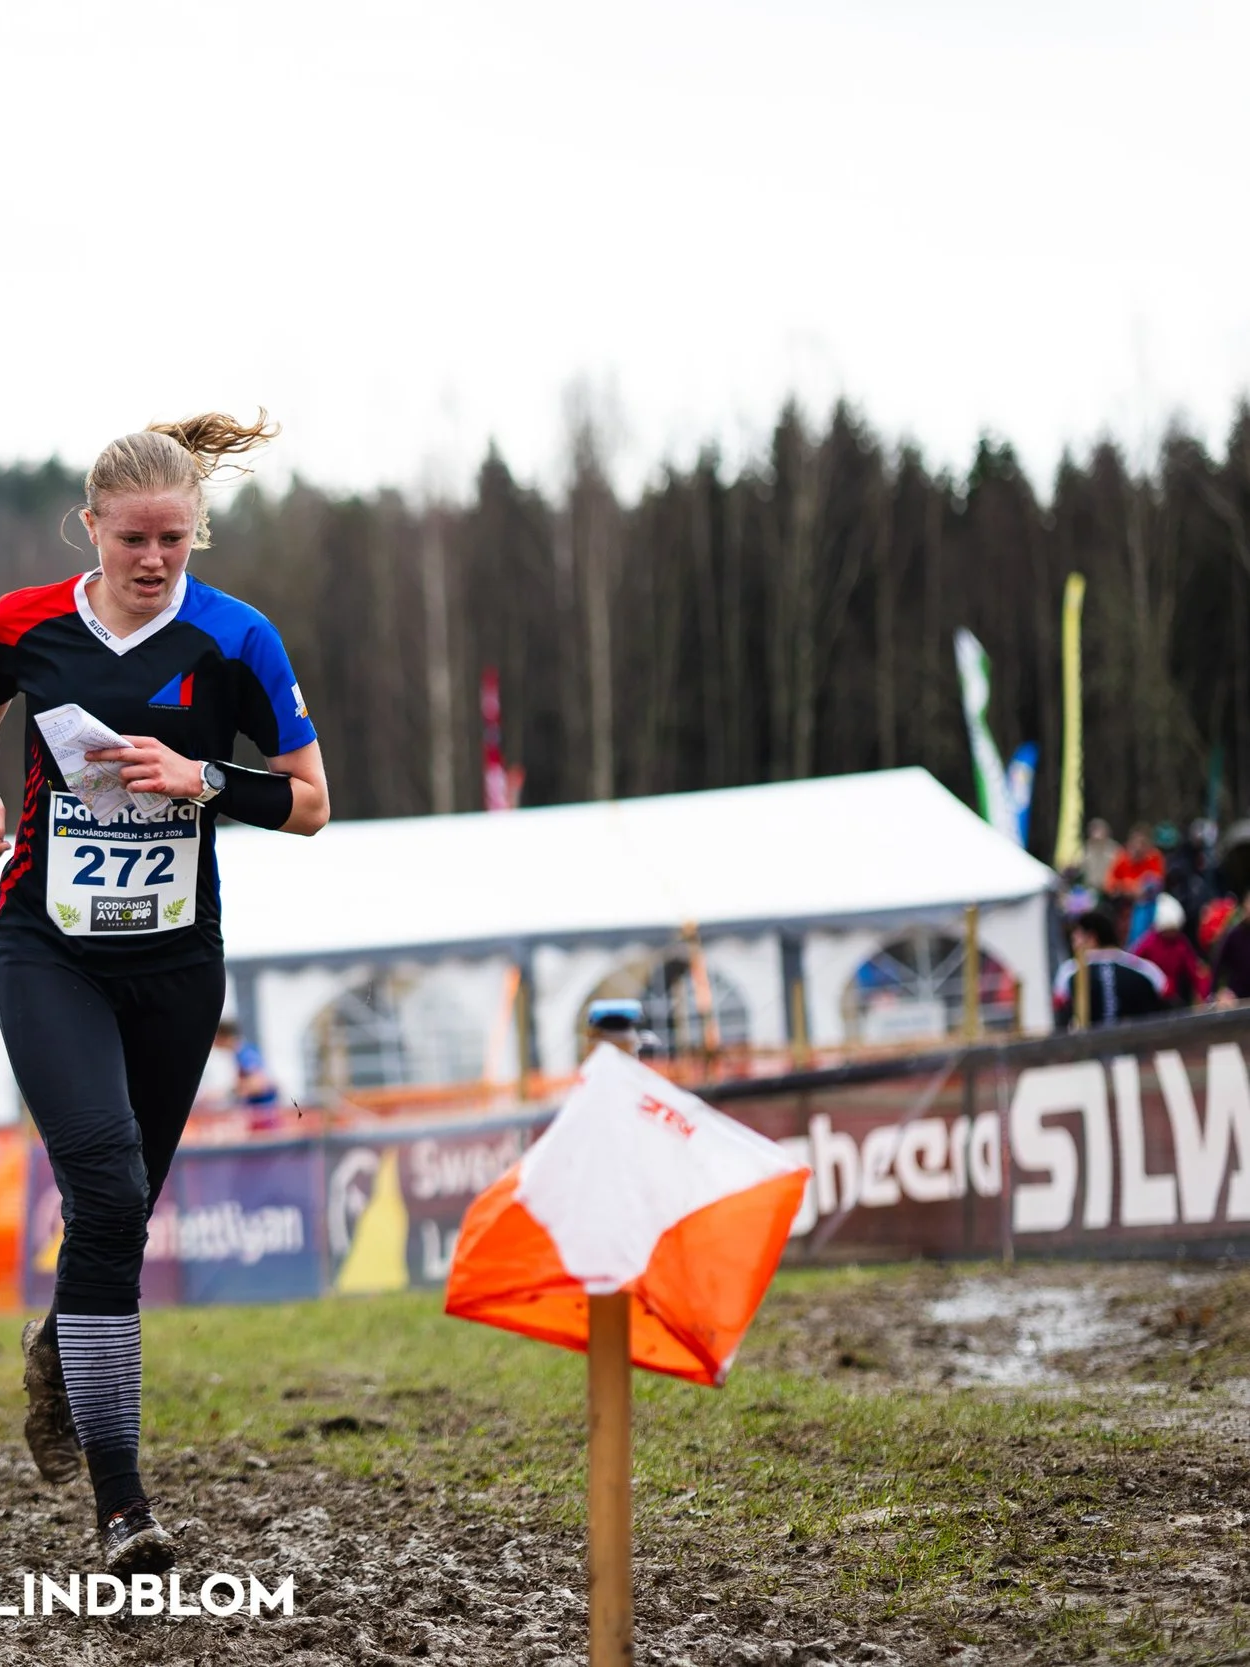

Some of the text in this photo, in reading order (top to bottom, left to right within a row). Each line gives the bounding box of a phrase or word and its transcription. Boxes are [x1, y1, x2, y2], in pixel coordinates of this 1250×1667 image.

[68, 827, 137, 840] KOLMÅRDSMEDELN
[153, 831, 164, 839] #2
[165, 829, 184, 838] 2026
[72, 845, 175, 887] 272
[96, 900, 153, 911] GODKÄNDA
